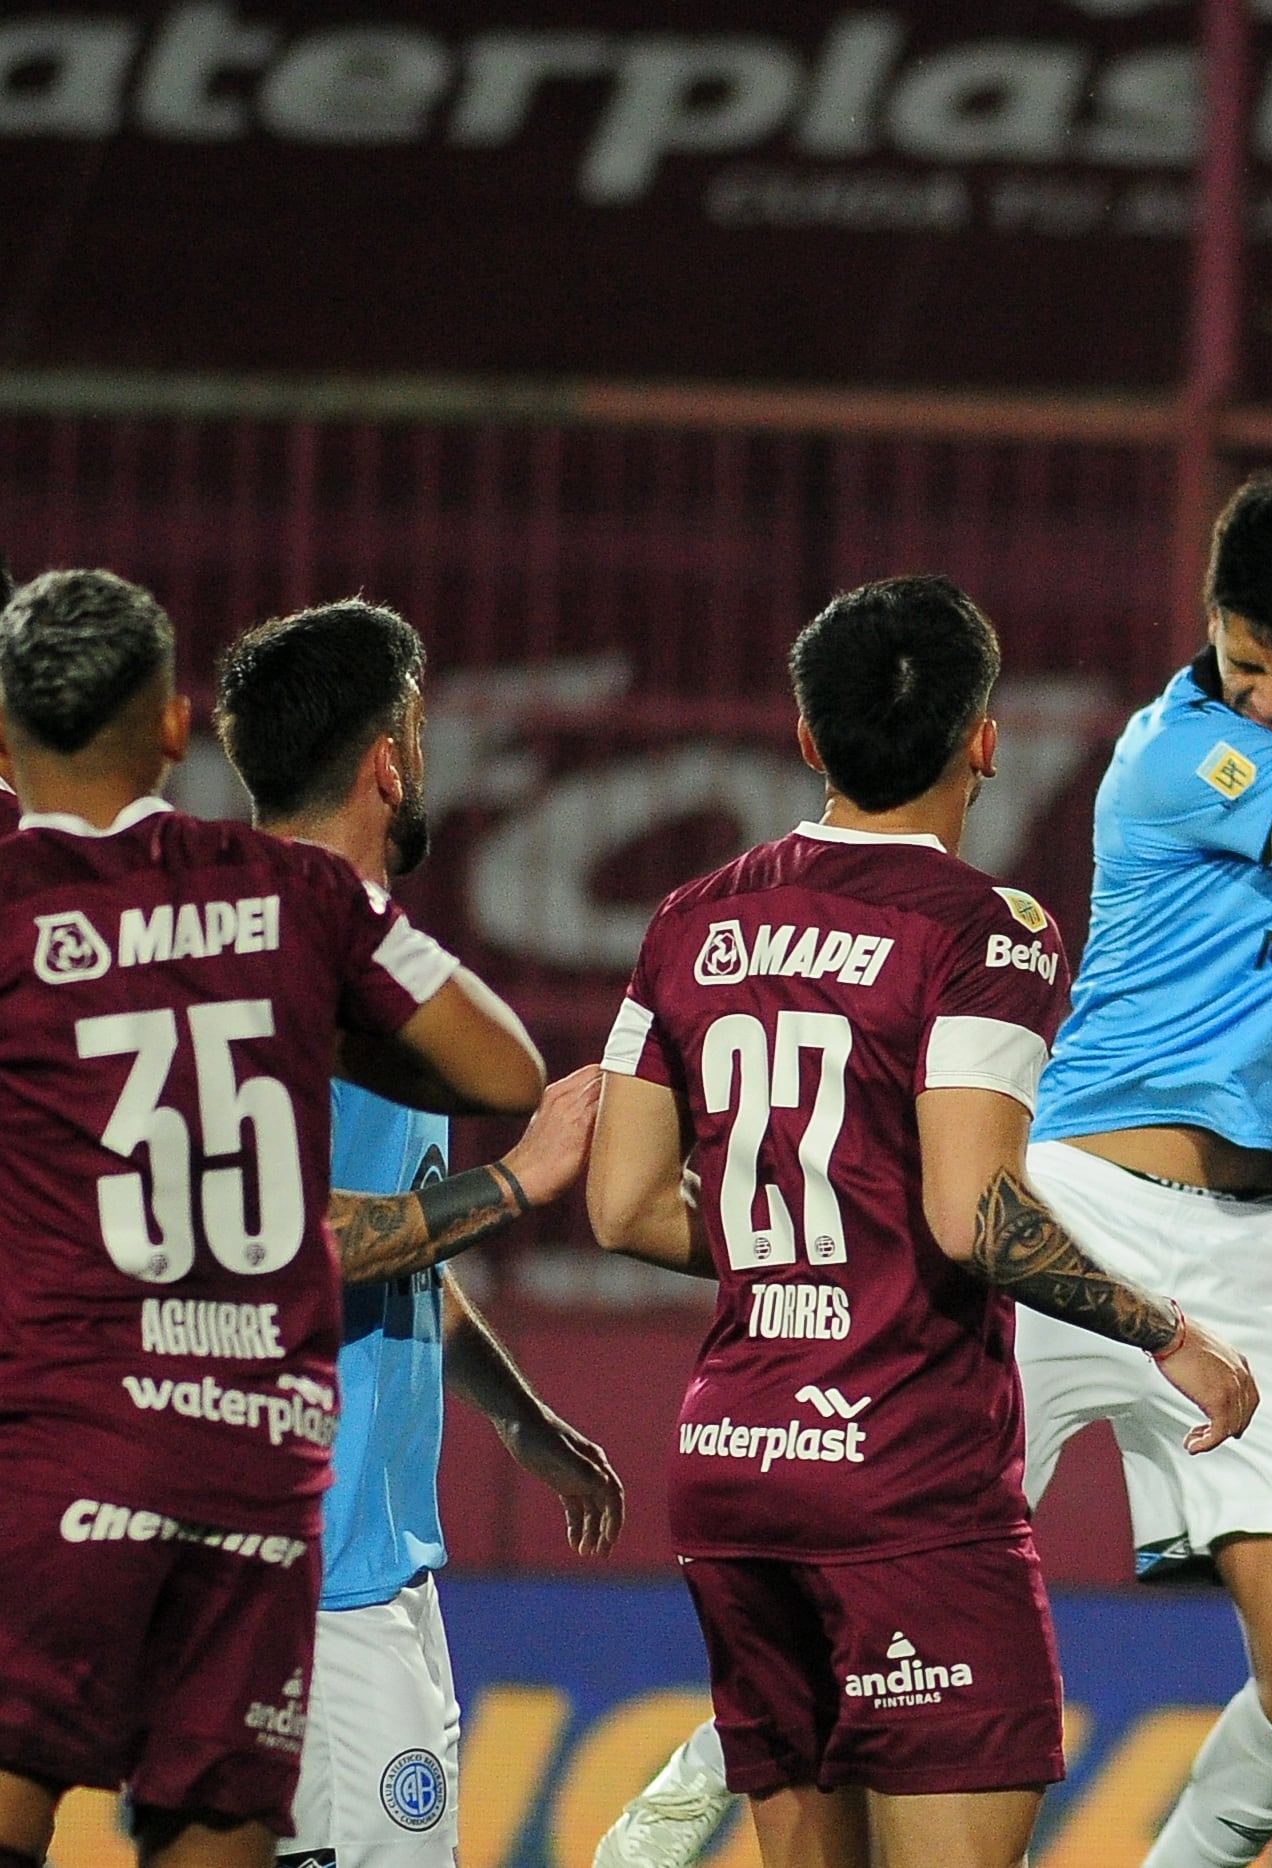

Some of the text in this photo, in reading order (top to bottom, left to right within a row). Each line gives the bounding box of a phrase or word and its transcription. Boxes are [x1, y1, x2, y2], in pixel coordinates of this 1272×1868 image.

[118, 895, 280, 968] MAPEI
[748, 925, 894, 986] MAPEI
[985, 934, 1059, 986] Befol
[75, 1000, 305, 1284] 35
[702, 1010, 852, 1270] 27
[141, 1298, 286, 1359] AGUIRRE
[749, 1284, 851, 1340] TORRES
[679, 1417, 866, 1472] waterplast
[845, 1659, 973, 1697] andina
[874, 1692, 942, 1709] PINTURAS
